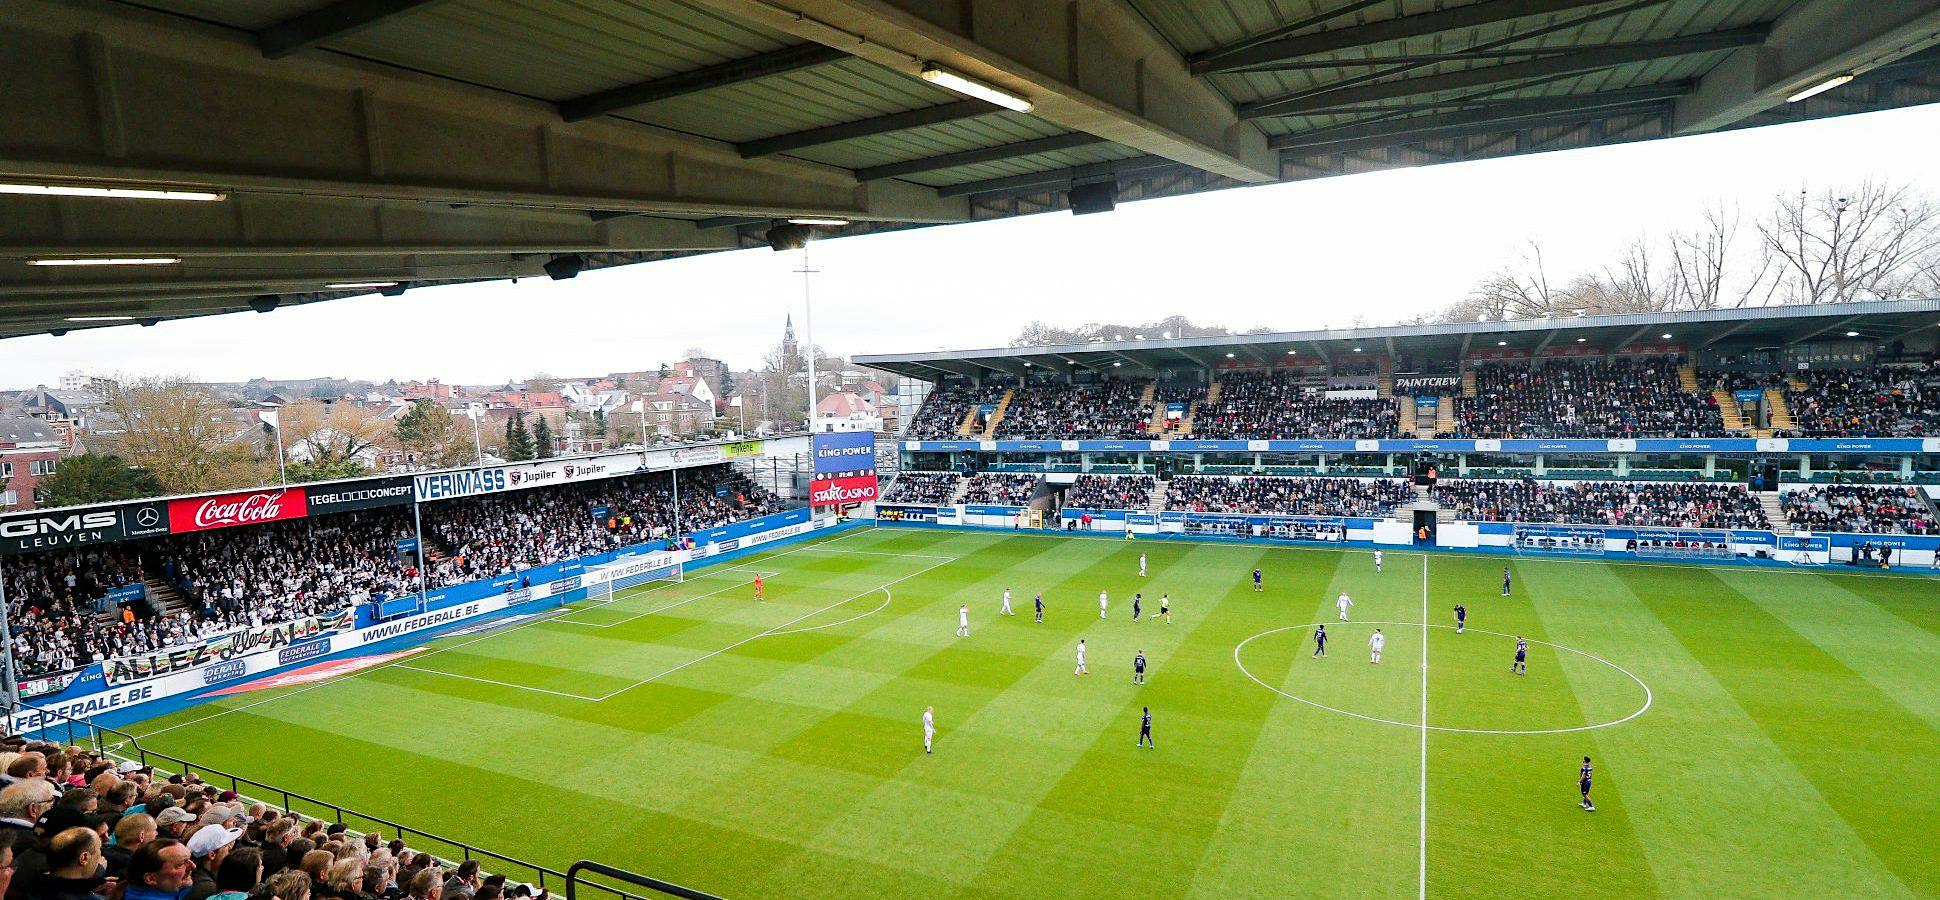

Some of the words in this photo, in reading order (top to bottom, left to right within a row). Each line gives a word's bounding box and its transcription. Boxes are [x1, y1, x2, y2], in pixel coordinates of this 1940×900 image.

[1397, 377, 1460, 387] PAINTCREW
[818, 449, 840, 458] KING
[842, 446, 871, 455] POWER
[523, 470, 556, 483] Jupiler
[576, 464, 606, 477] Jupiler
[416, 469, 505, 499] VERIMASS
[195, 491, 281, 527] Coca-Cola
[0, 511, 116, 538] GMS
[20, 531, 102, 549] LEUVEN
[362, 604, 480, 642] WWW.FEDERALE.BE
[280, 642, 321, 659] FEDERALE
[111, 645, 211, 683] ALLEZ
[81, 673, 102, 683] KING
